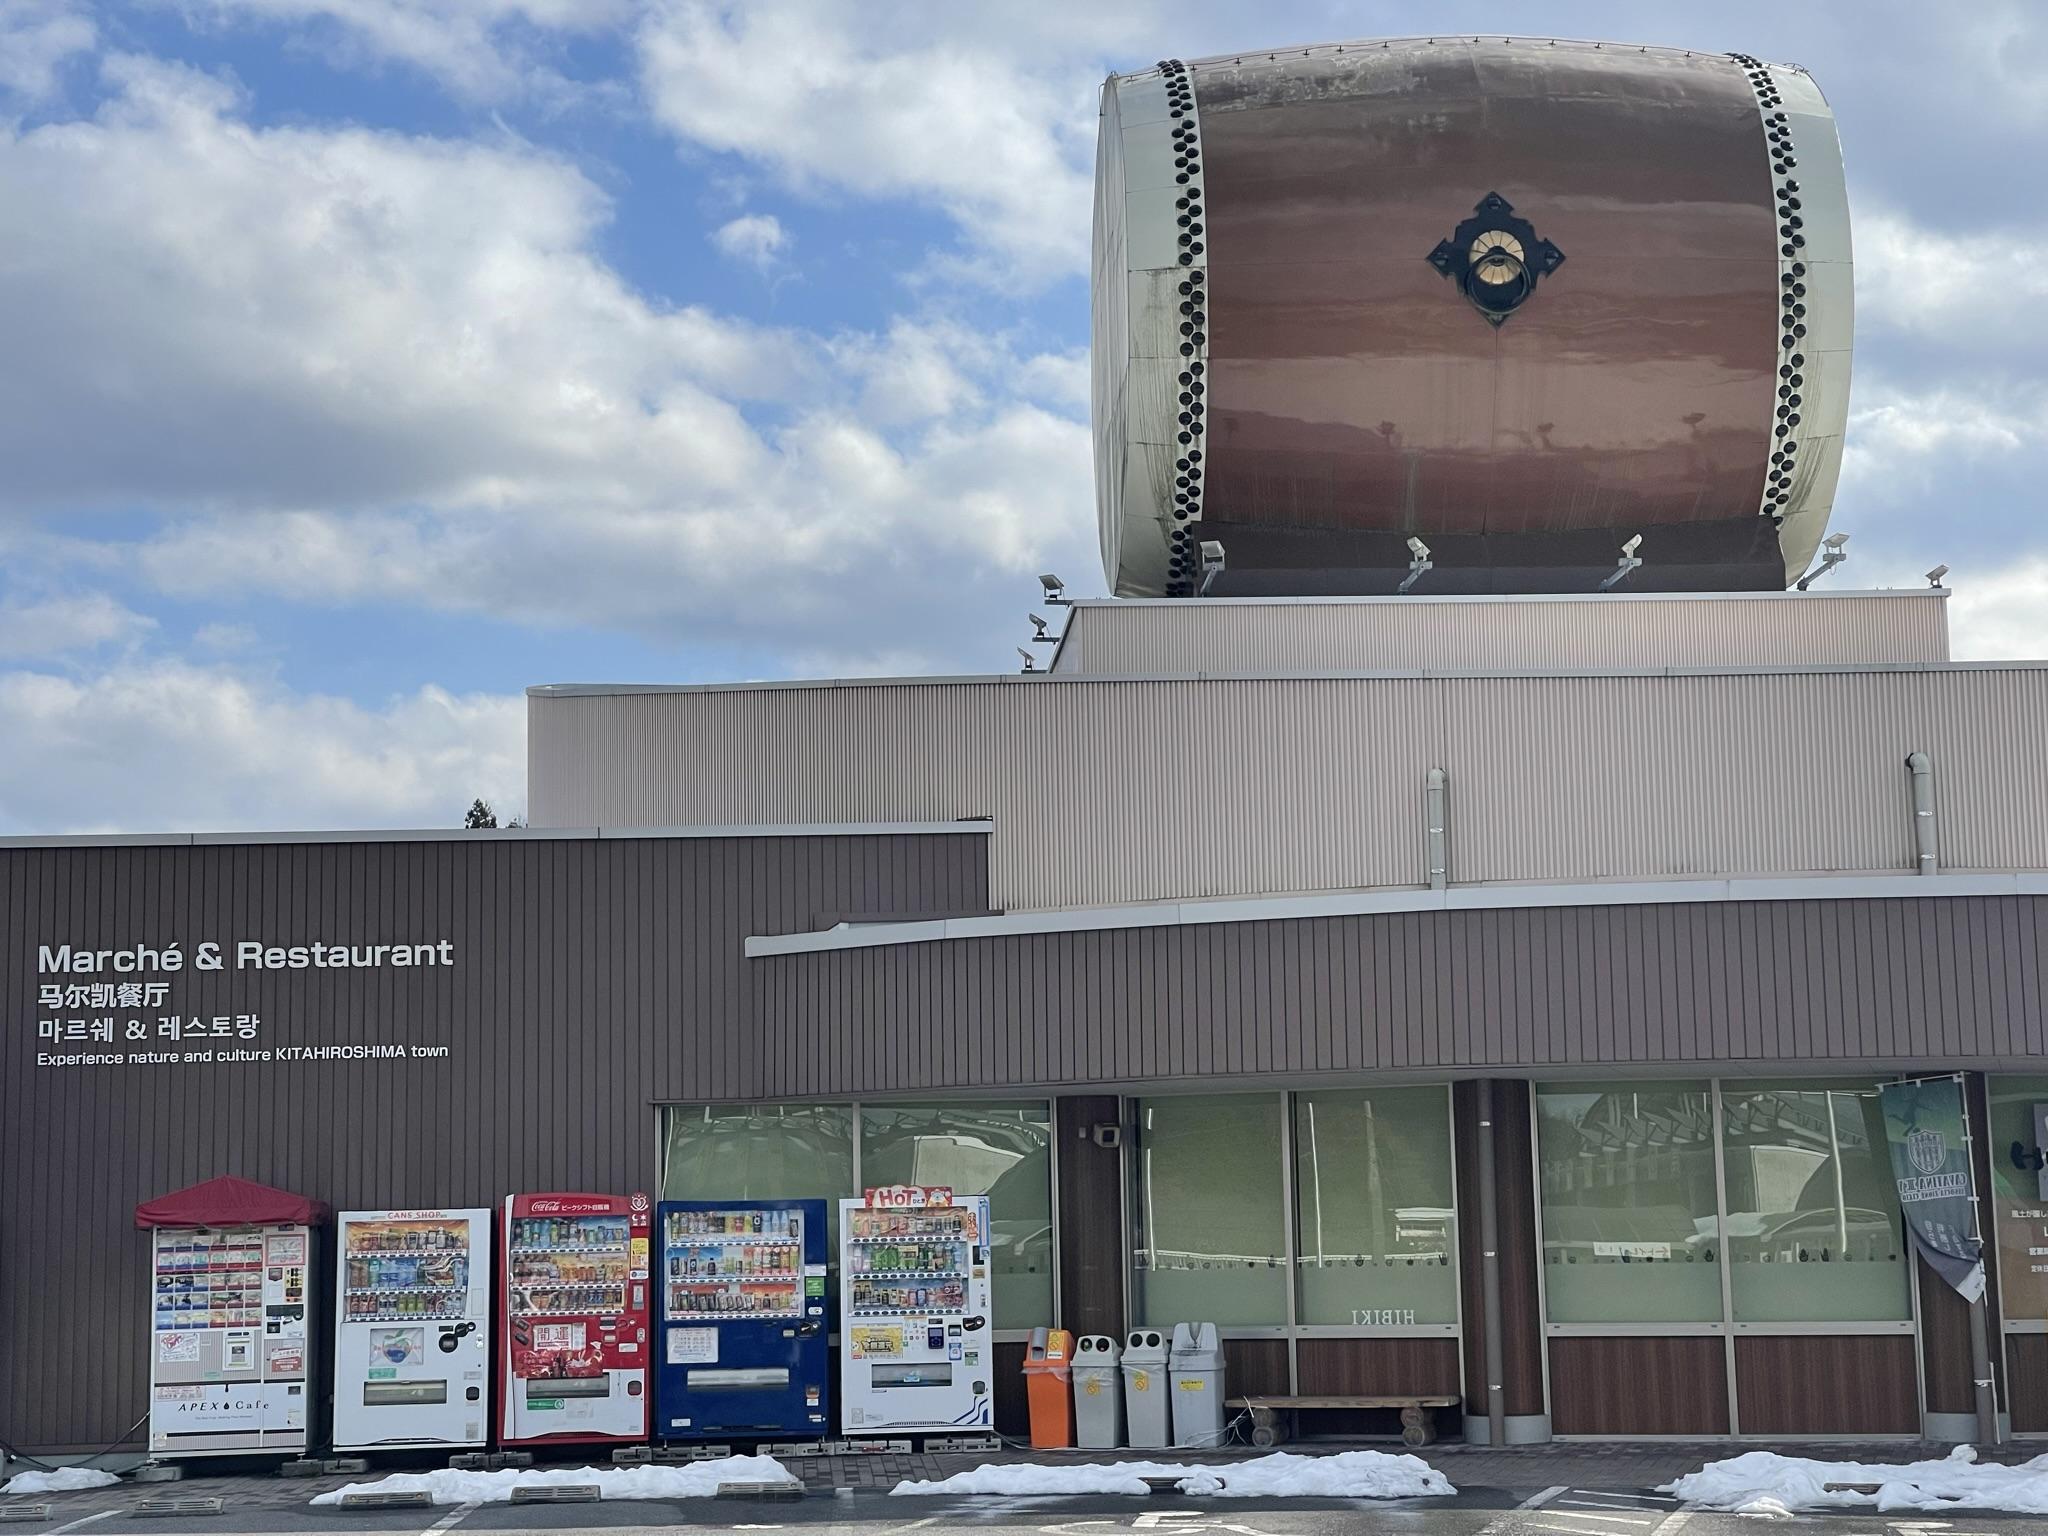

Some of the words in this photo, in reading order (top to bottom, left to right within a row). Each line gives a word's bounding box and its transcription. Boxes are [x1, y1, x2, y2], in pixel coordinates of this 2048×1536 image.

[38, 942, 183, 974] Marché
[194, 941, 224, 971] &
[237, 939, 454, 970] Restaurant
[38, 982, 170, 1010] 马尔凯餐厅
[38, 1017, 114, 1044] 마르쉐
[125, 1018, 148, 1041] &
[158, 1014, 260, 1041] 레스토랑
[37, 1051, 124, 1067] Experience
[128, 1050, 180, 1064] nature
[183, 1048, 212, 1063] and
[216, 1047, 271, 1062] culture
[275, 1045, 406, 1061] KITAHIROSHIMA
[411, 1045, 449, 1058] town
[387, 1211, 413, 1220] CANS
[416, 1211, 441, 1219] SHOP
[178, 1402, 220, 1412] APEX
[235, 1400, 269, 1410] Cafe
